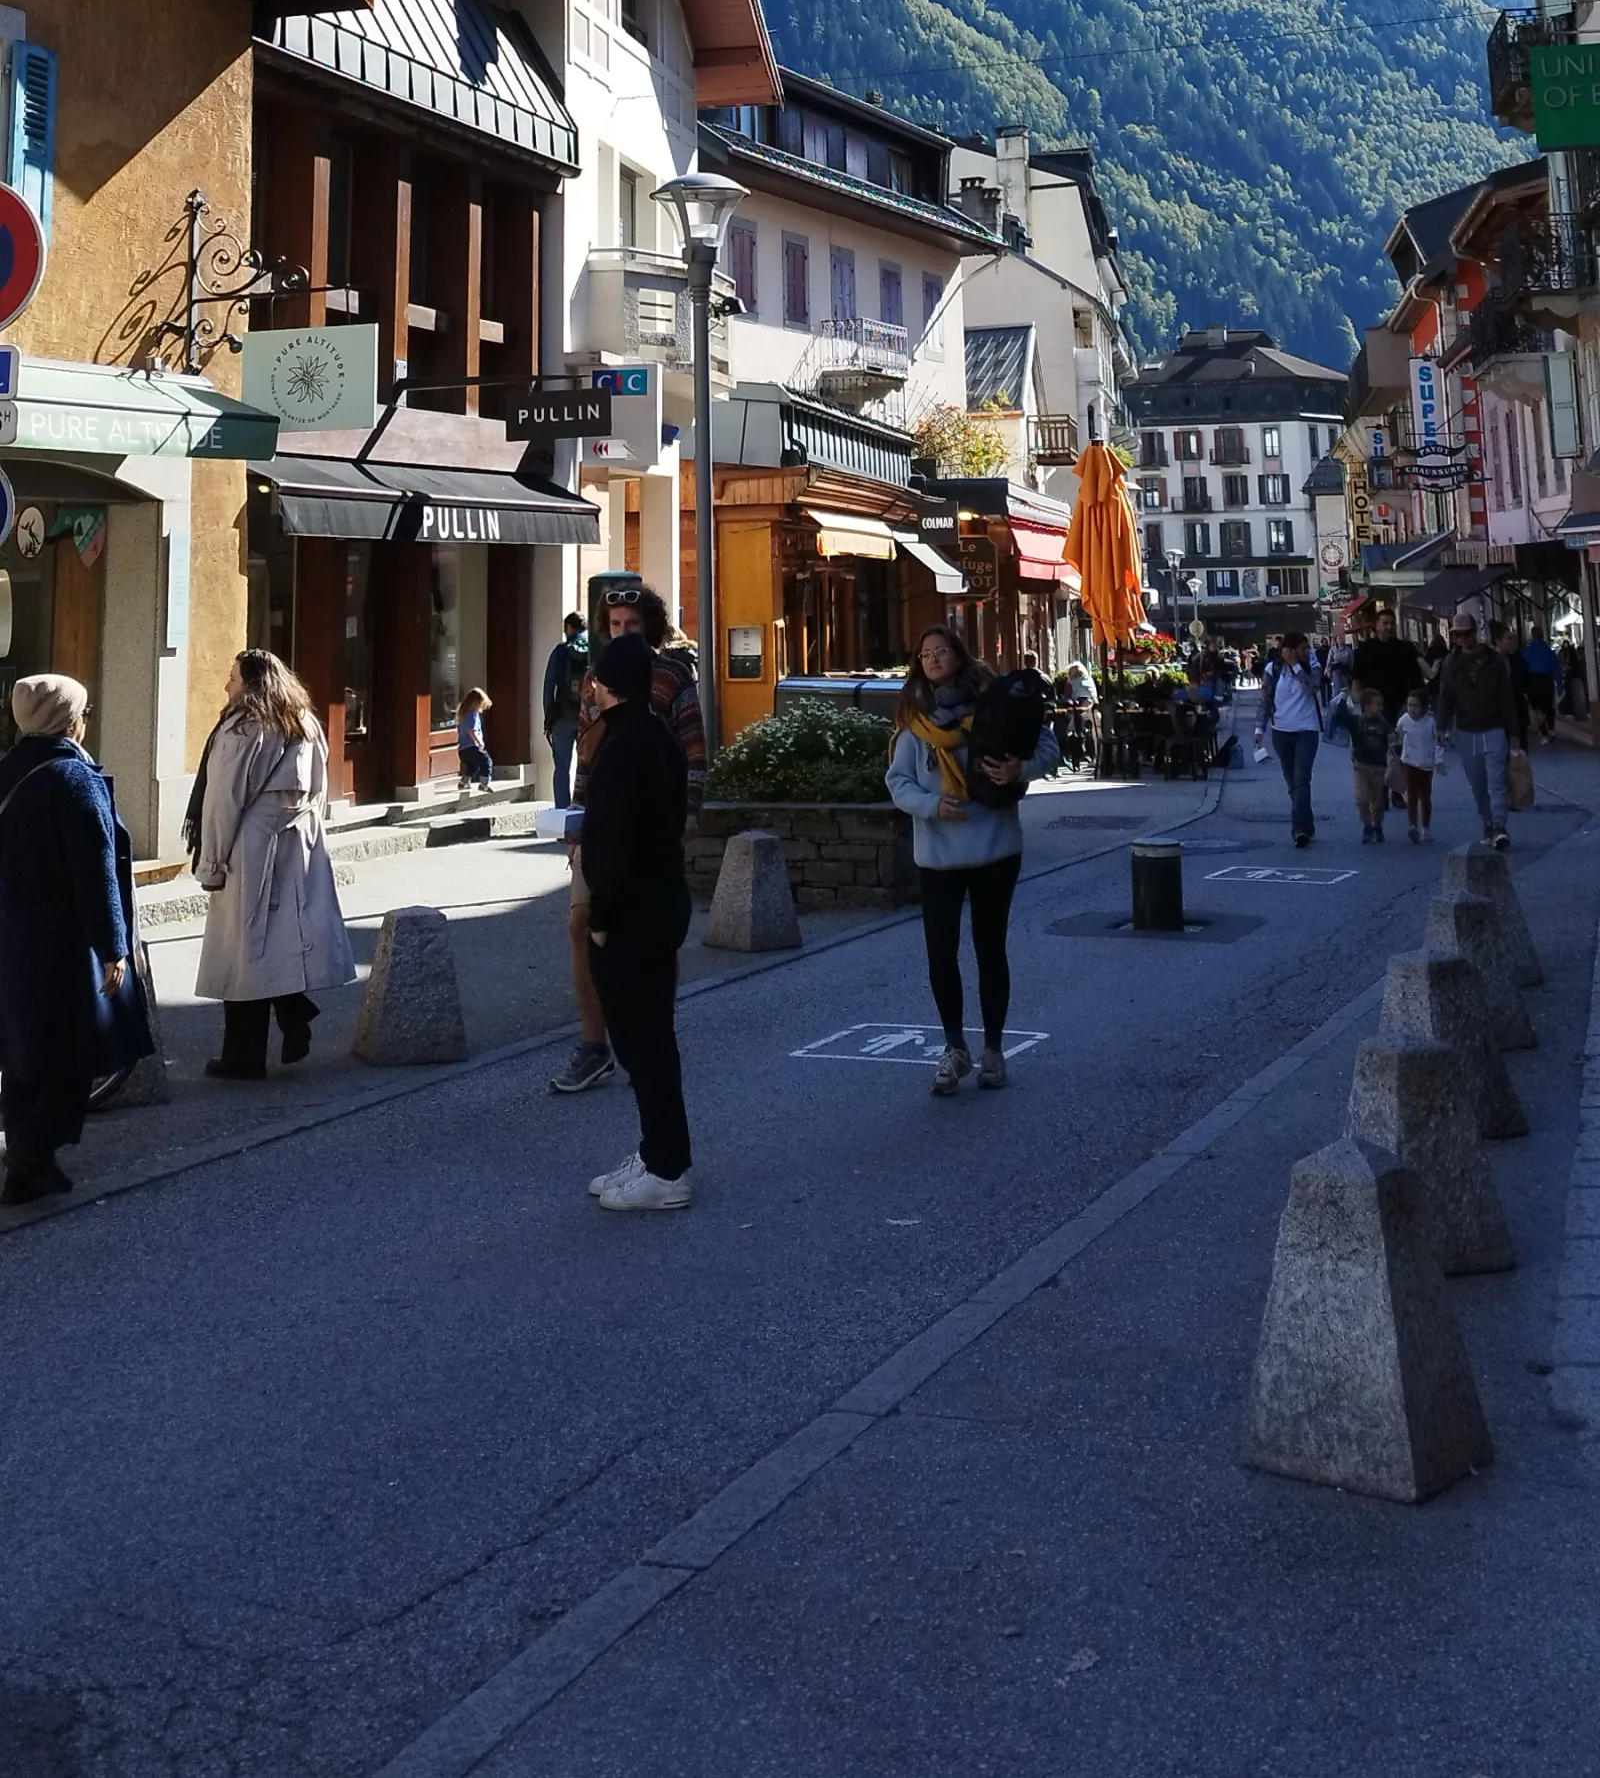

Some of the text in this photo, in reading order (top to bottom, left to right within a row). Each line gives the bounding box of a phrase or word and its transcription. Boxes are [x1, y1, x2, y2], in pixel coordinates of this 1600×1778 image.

[1541, 53, 1600, 78] UNI
[1543, 85, 1582, 108] OF
[276, 336, 346, 379] PURE ALTITUDE
[597, 373, 642, 391] CIC
[518, 403, 600, 425] PULLIN
[31, 412, 223, 450] PURE ALTITUDE
[1419, 445, 1450, 455] PAYOT
[1405, 464, 1469, 476] CHAUSSURES
[422, 505, 501, 540] PULLIN
[921, 516, 954, 530] COLMAR
[959, 541, 977, 553] Le
[957, 556, 993, 574] fuge
